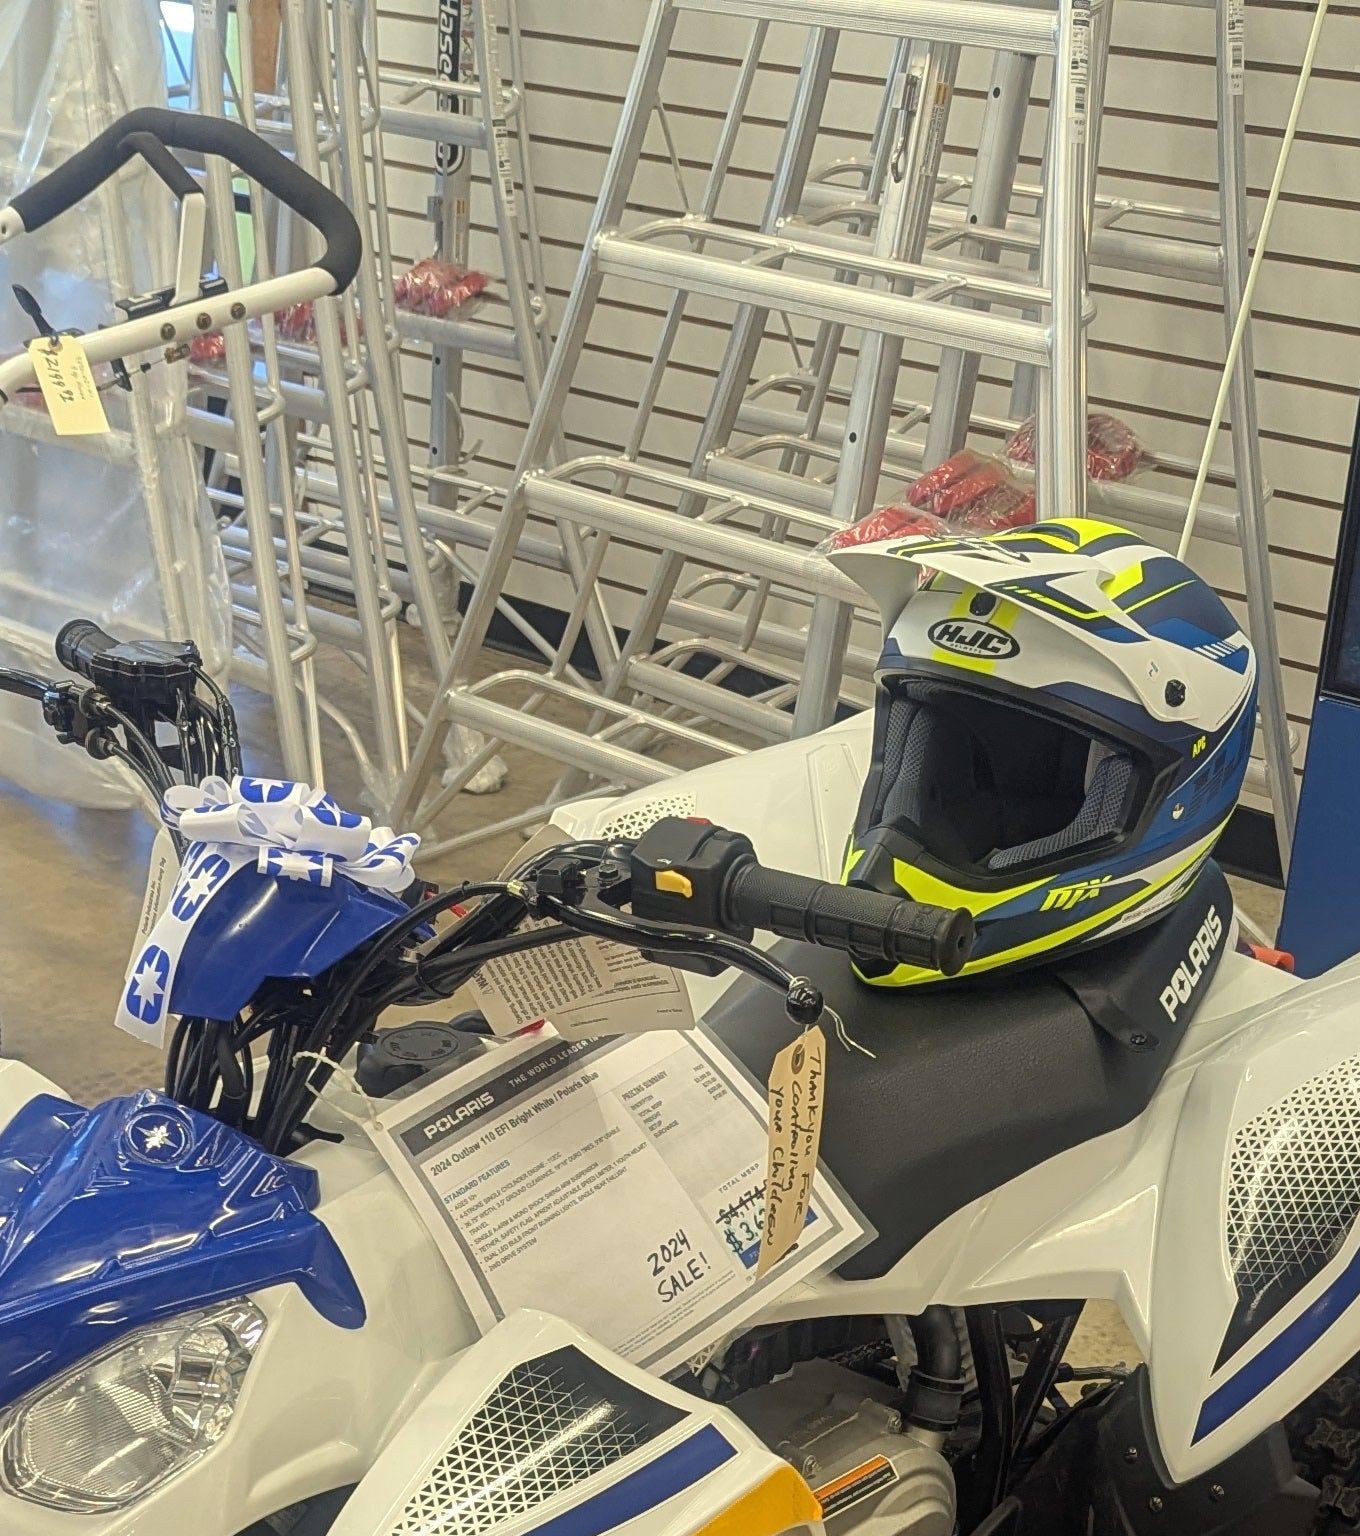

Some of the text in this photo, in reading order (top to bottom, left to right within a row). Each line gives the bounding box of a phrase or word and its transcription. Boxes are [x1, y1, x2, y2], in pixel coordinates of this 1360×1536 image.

[936, 625, 1010, 653] HJC
[541, 972, 551, 985] avoid
[567, 947, 594, 992] For more information
[1159, 905, 1223, 1022] POLARIS
[510, 970, 539, 1017] engine carbon
[532, 975, 554, 1010] and birth defects
[535, 1000, 546, 1013] which
[422, 1036, 590, 1140] POLARIS THE WORLD LEADER
[429, 1069, 599, 1176] 2024 Outlaw 110 EFI Bright White Polaris Blue
[442, 1158, 511, 1204] STANDARD FEATURES
[526, 1161, 545, 1176] ENGINE
[718, 1163, 760, 1194] TOTAL MSRP
[453, 1198, 469, 1211] AGES
[473, 1161, 599, 1245] SINGLE MONO SUSPENSION
[499, 1175, 596, 1240] SAFETY ADJUSTABLE SPEED
[504, 1185, 527, 1202] GROUND
[520, 1179, 607, 1238] FRONT RUNNING REAR
[468, 1220, 488, 1236] TRAVEL
[499, 1237, 538, 1264] DRIVE SYSTEM
[647, 1229, 691, 1277] 2024
[658, 1252, 711, 1303] SALE!
